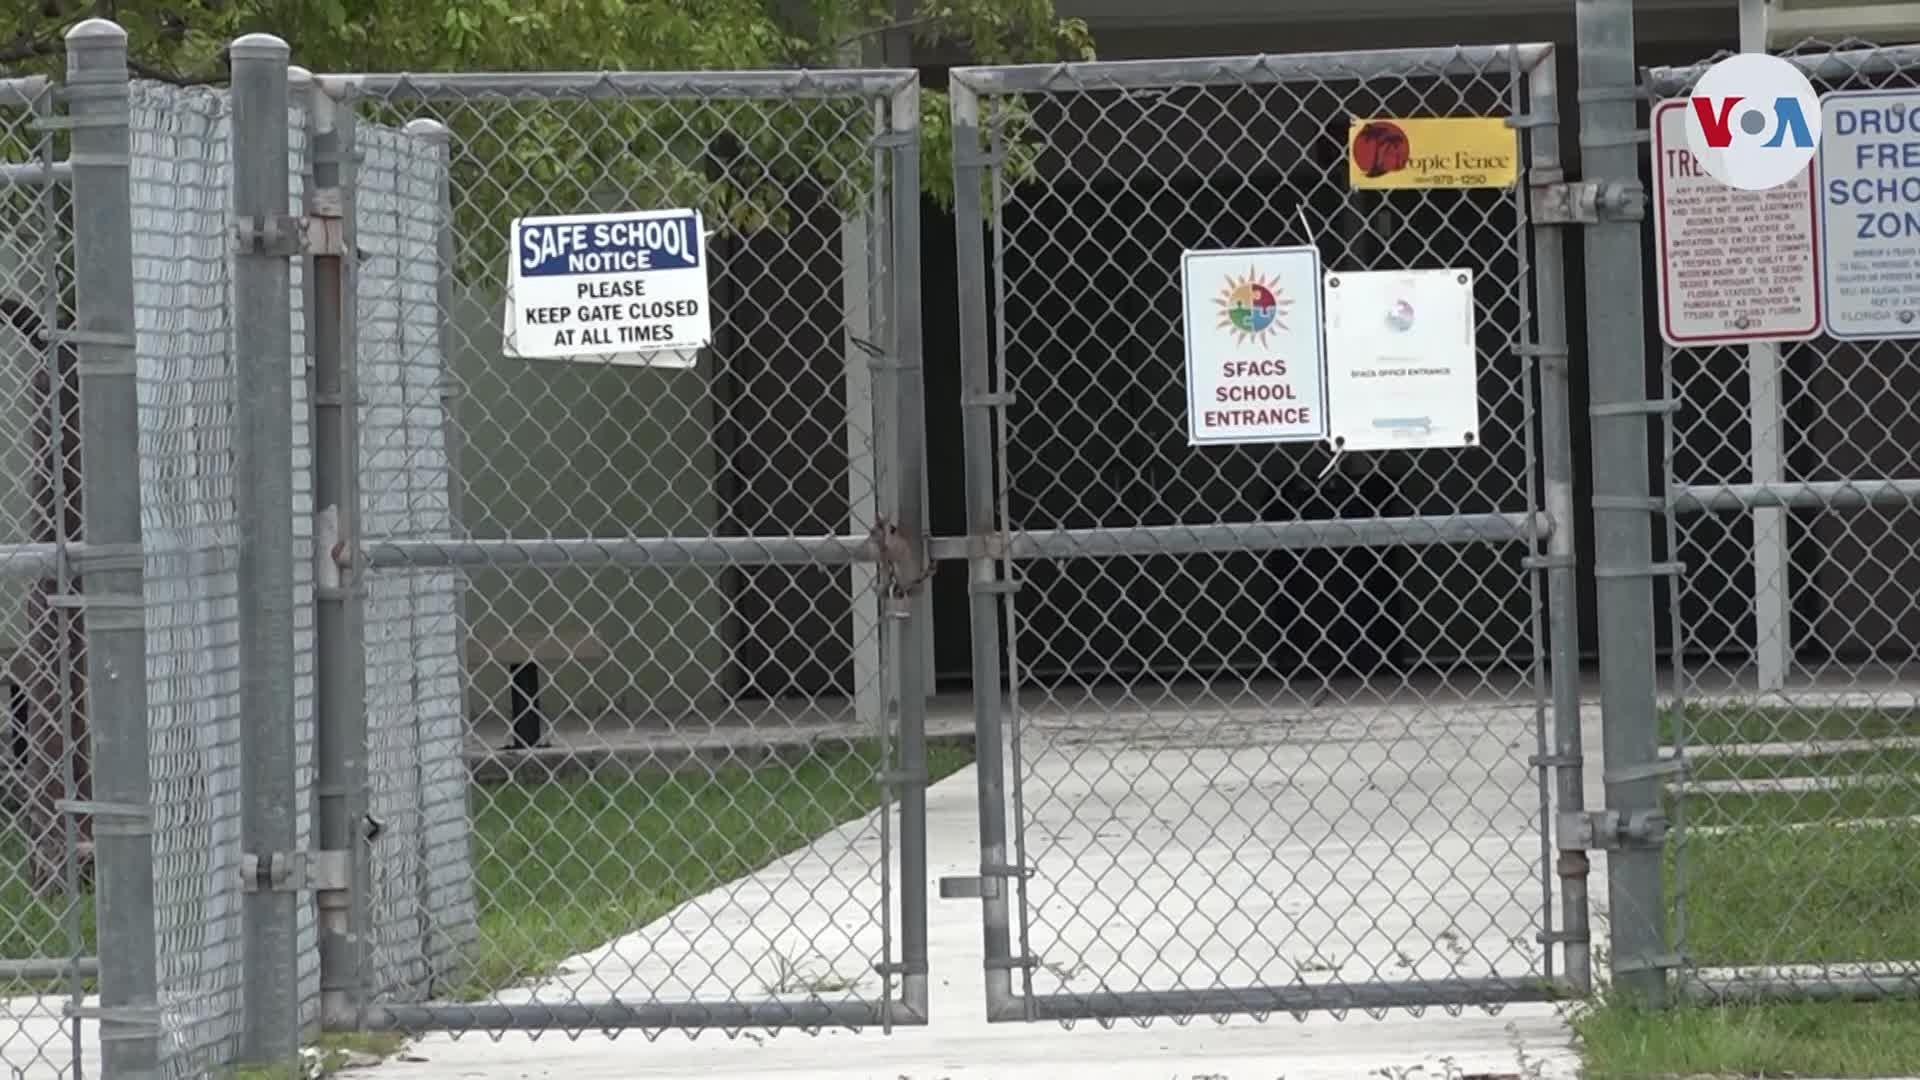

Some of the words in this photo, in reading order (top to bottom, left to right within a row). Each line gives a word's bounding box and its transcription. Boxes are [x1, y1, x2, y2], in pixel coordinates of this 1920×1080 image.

[1455, 151, 1509, 170] Fence
[523, 226, 588, 268] SAFE
[593, 220, 695, 264] SCHOOL
[568, 250, 651, 272] NOTICE
[577, 280, 646, 298] PLEASE
[526, 307, 571, 325] KEEP
[578, 304, 624, 322] GATE
[629, 299, 698, 320] CLOSED
[554, 329, 576, 346] AT
[581, 327, 613, 345] ALL
[618, 324, 674, 343] TIMES
[1223, 360, 1287, 378] SFACS
[1408, 367, 1451, 376] ENTRANCE
[1216, 384, 1297, 402] SCHOOL
[1205, 407, 1310, 427] ENTRANCE
